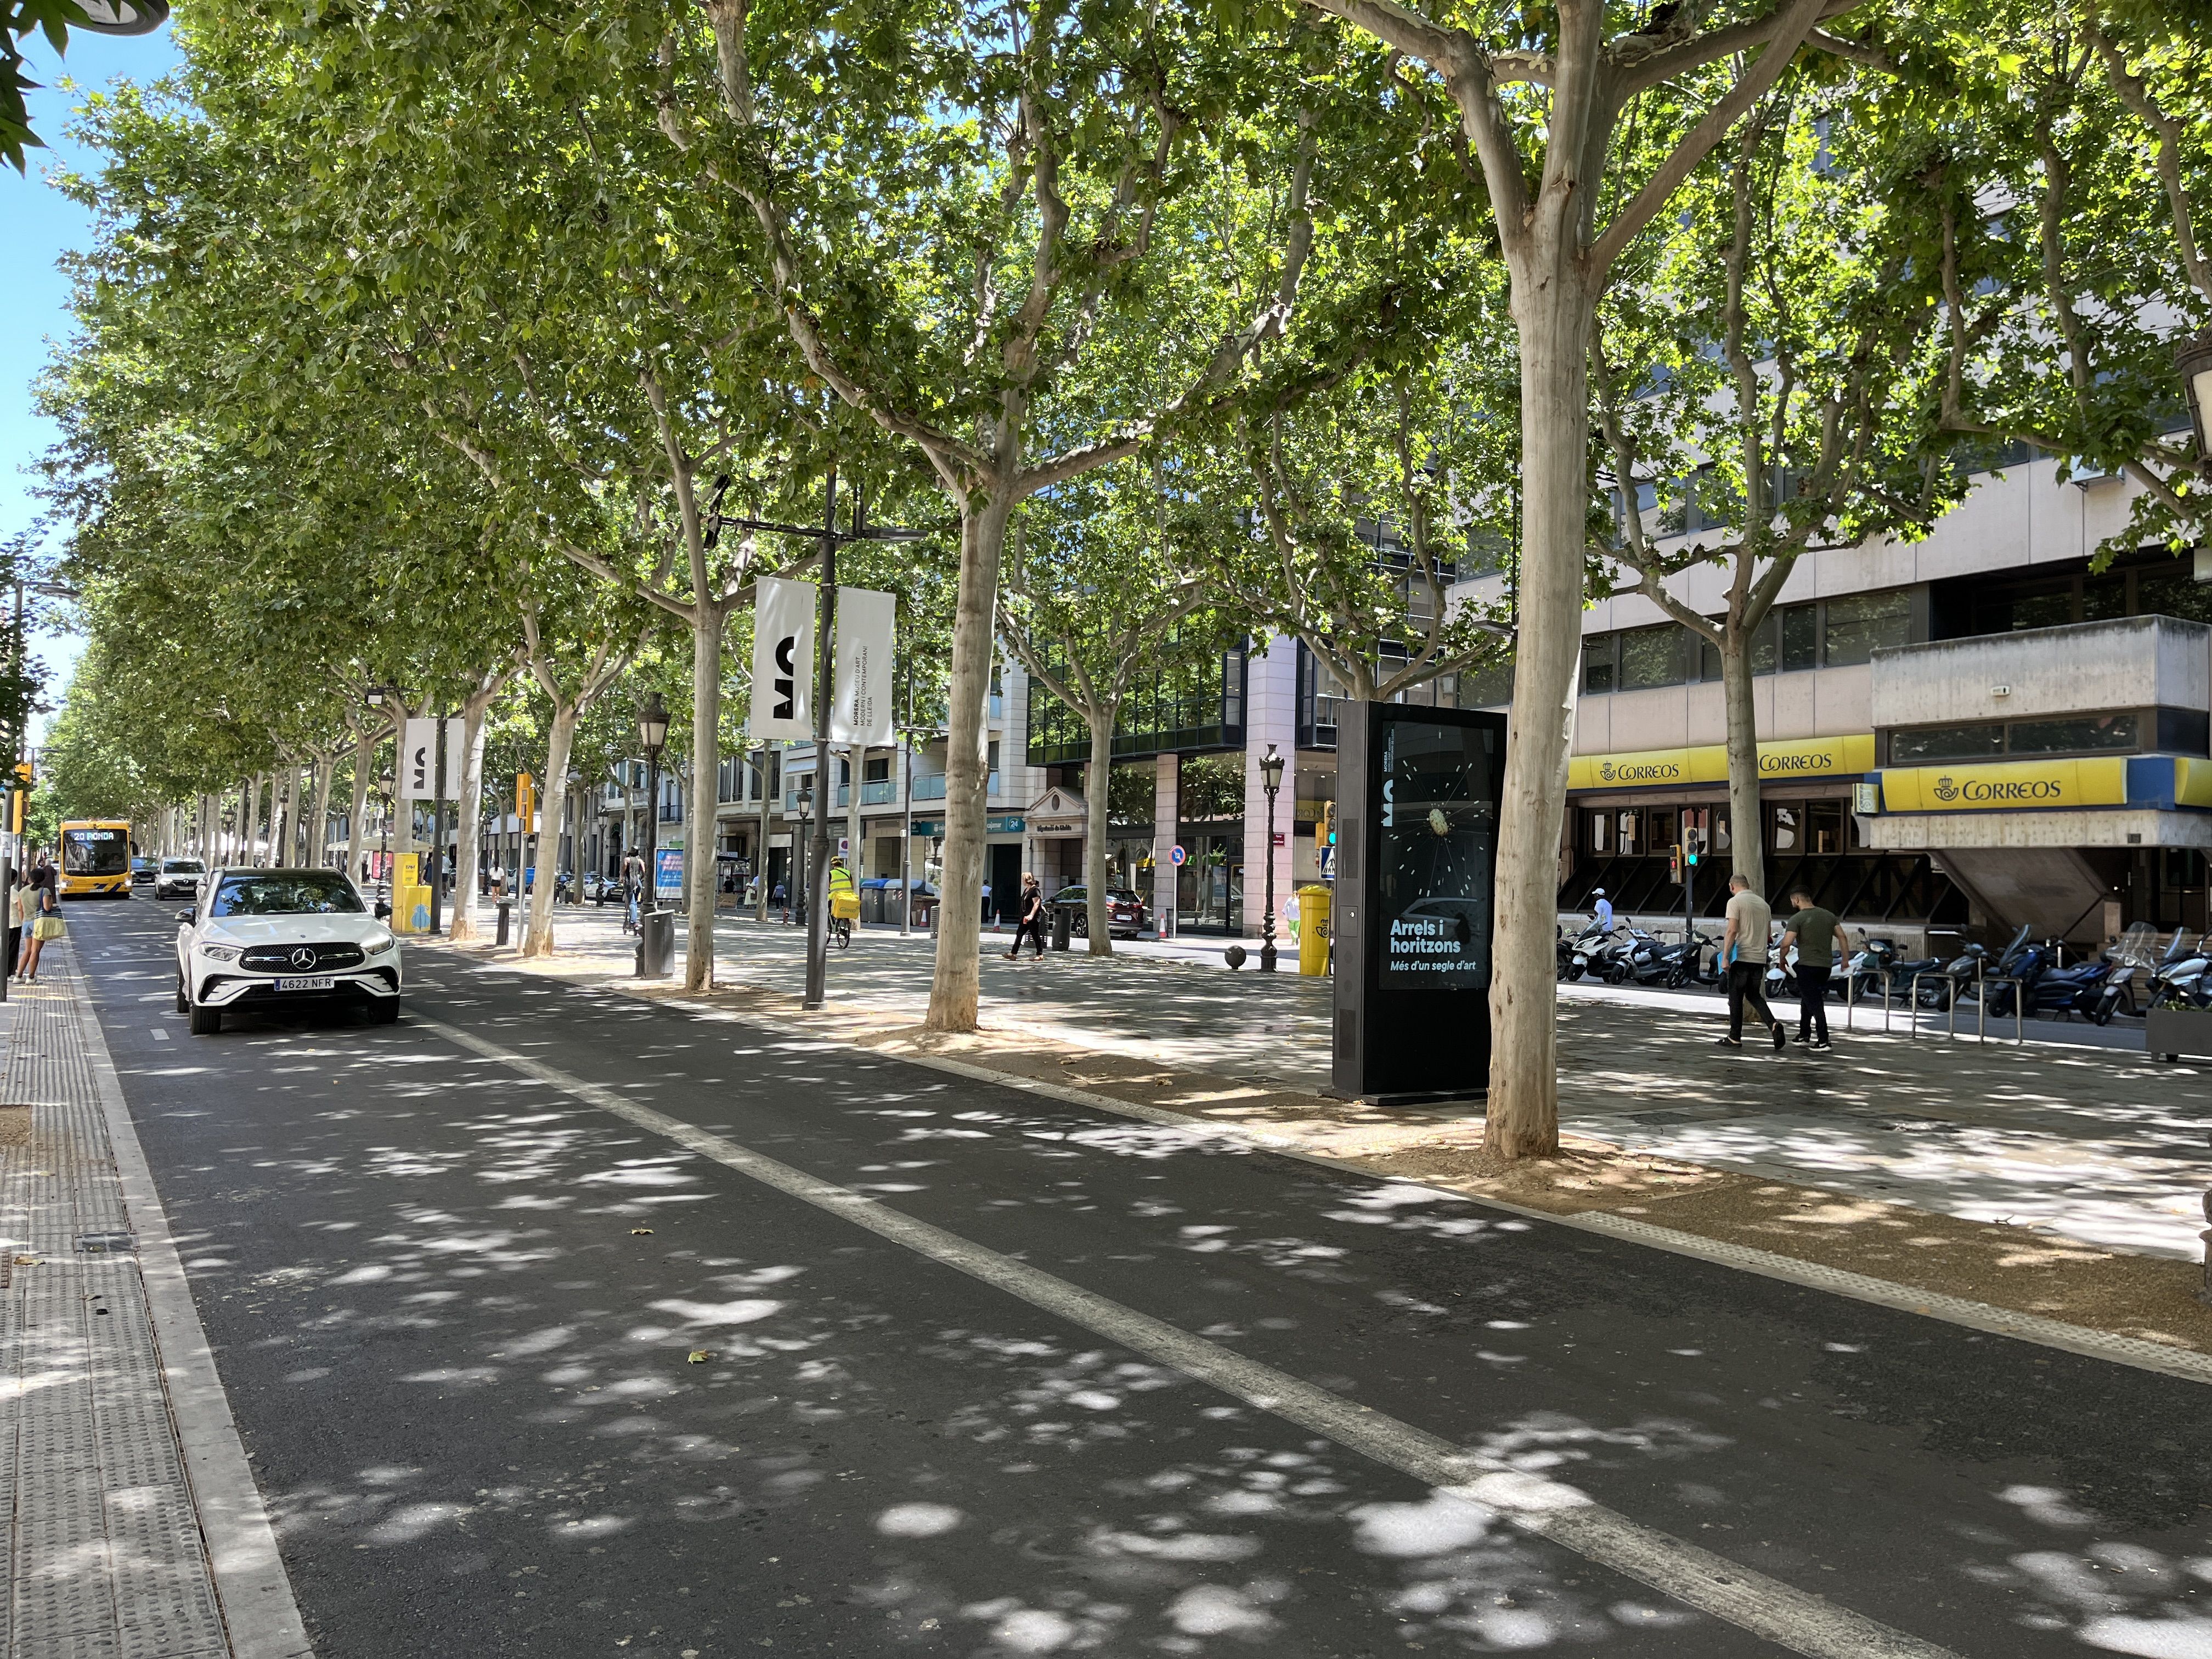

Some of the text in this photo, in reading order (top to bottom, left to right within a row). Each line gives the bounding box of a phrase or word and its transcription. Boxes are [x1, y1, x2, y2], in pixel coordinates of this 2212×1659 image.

[867, 718, 872, 727] DE
[1759, 753, 1832, 771] CORREOS
[1618, 764, 1679, 780] CORREOS
[1963, 780, 2061, 800] CORREOS
[87, 832, 114, 840] RONDA
[1390, 919, 1443, 935] Arrels i
[1390, 936, 1461, 953] horitzons
[1390, 960, 1476, 973] Més d'un segle d'art
[282, 978, 331, 989] 4622 NFR
